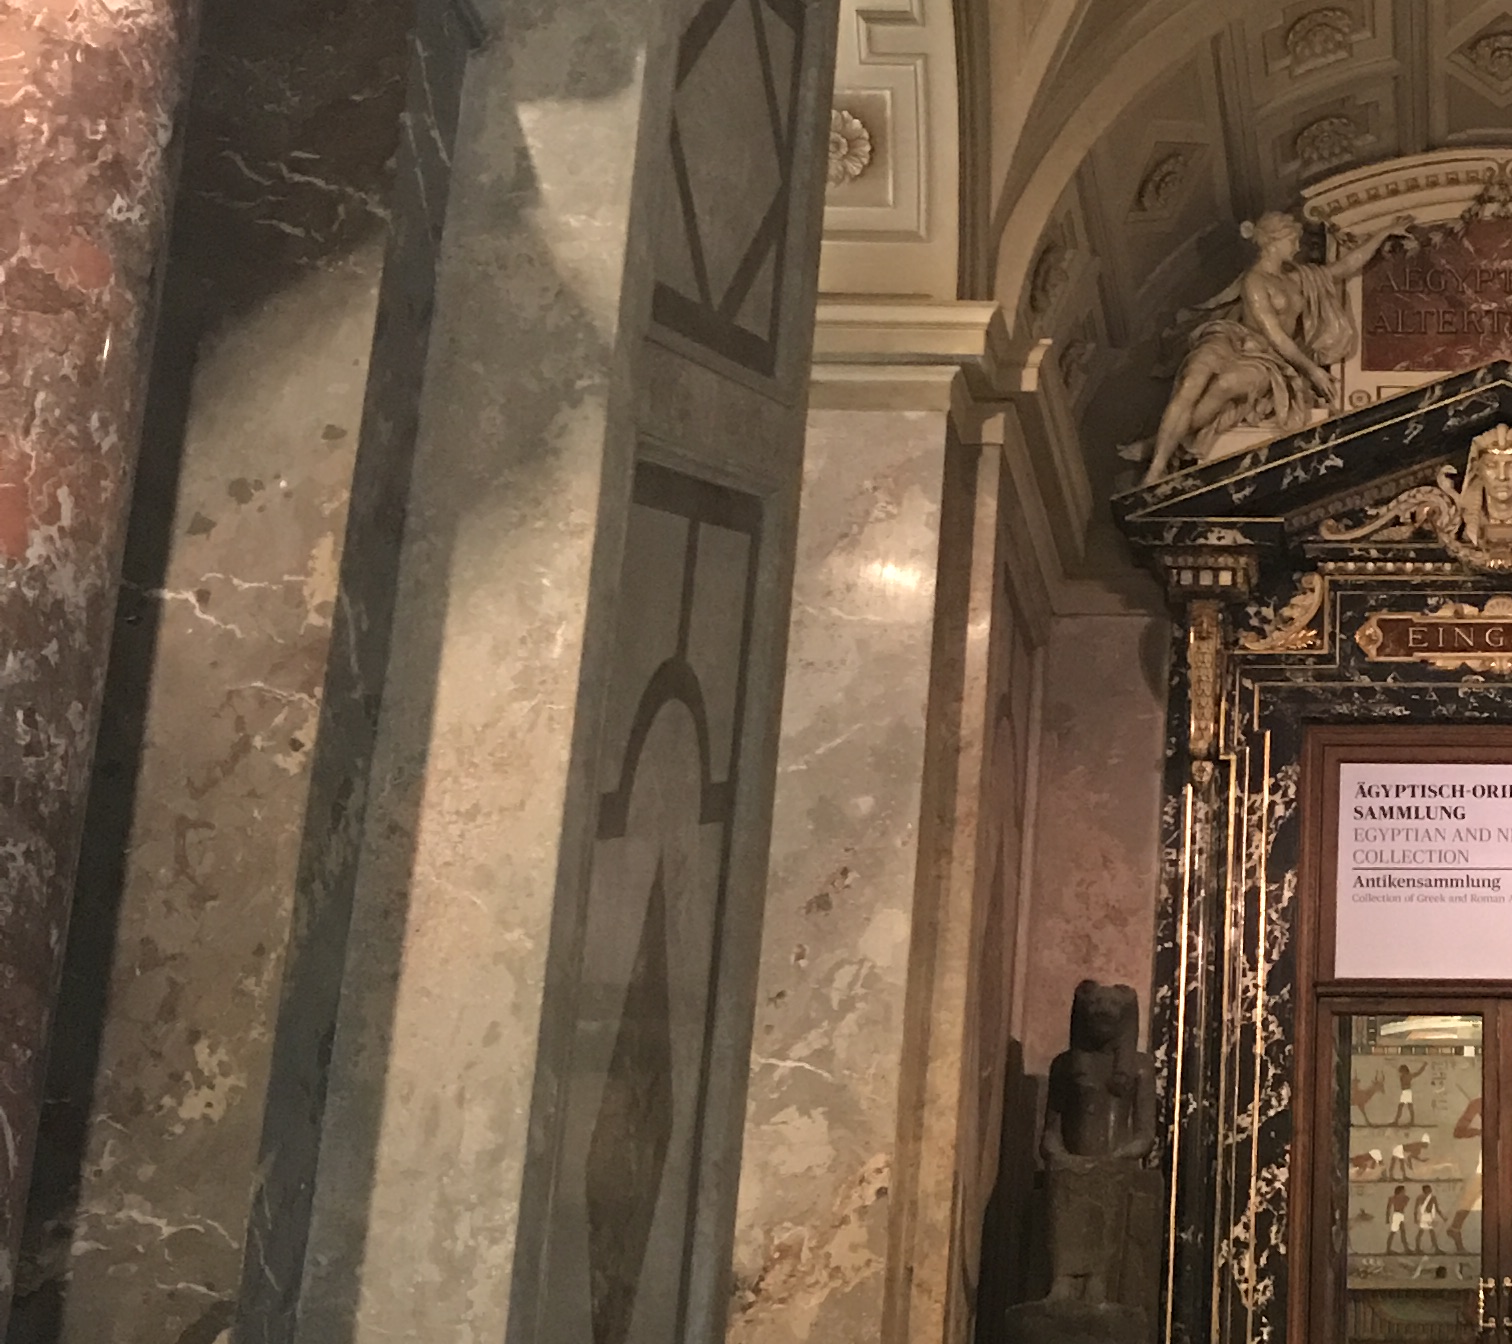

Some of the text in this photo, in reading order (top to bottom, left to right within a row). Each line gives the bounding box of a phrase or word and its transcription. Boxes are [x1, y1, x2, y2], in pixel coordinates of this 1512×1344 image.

[1353, 805, 1466, 821] SAMMLUNG
[1353, 827, 1447, 843] EGYPTIAN
[1452, 827, 1492, 843] AND
[1352, 848, 1470, 865] COLLECTION
[1352, 874, 1501, 892] Antikensammlung
[1351, 892, 1402, 904] Collection
[1404, 892, 1415, 904] of
[1416, 892, 1446, 904] Greek
[1449, 893, 1467, 904] and
[1470, 893, 1505, 904] Roman
